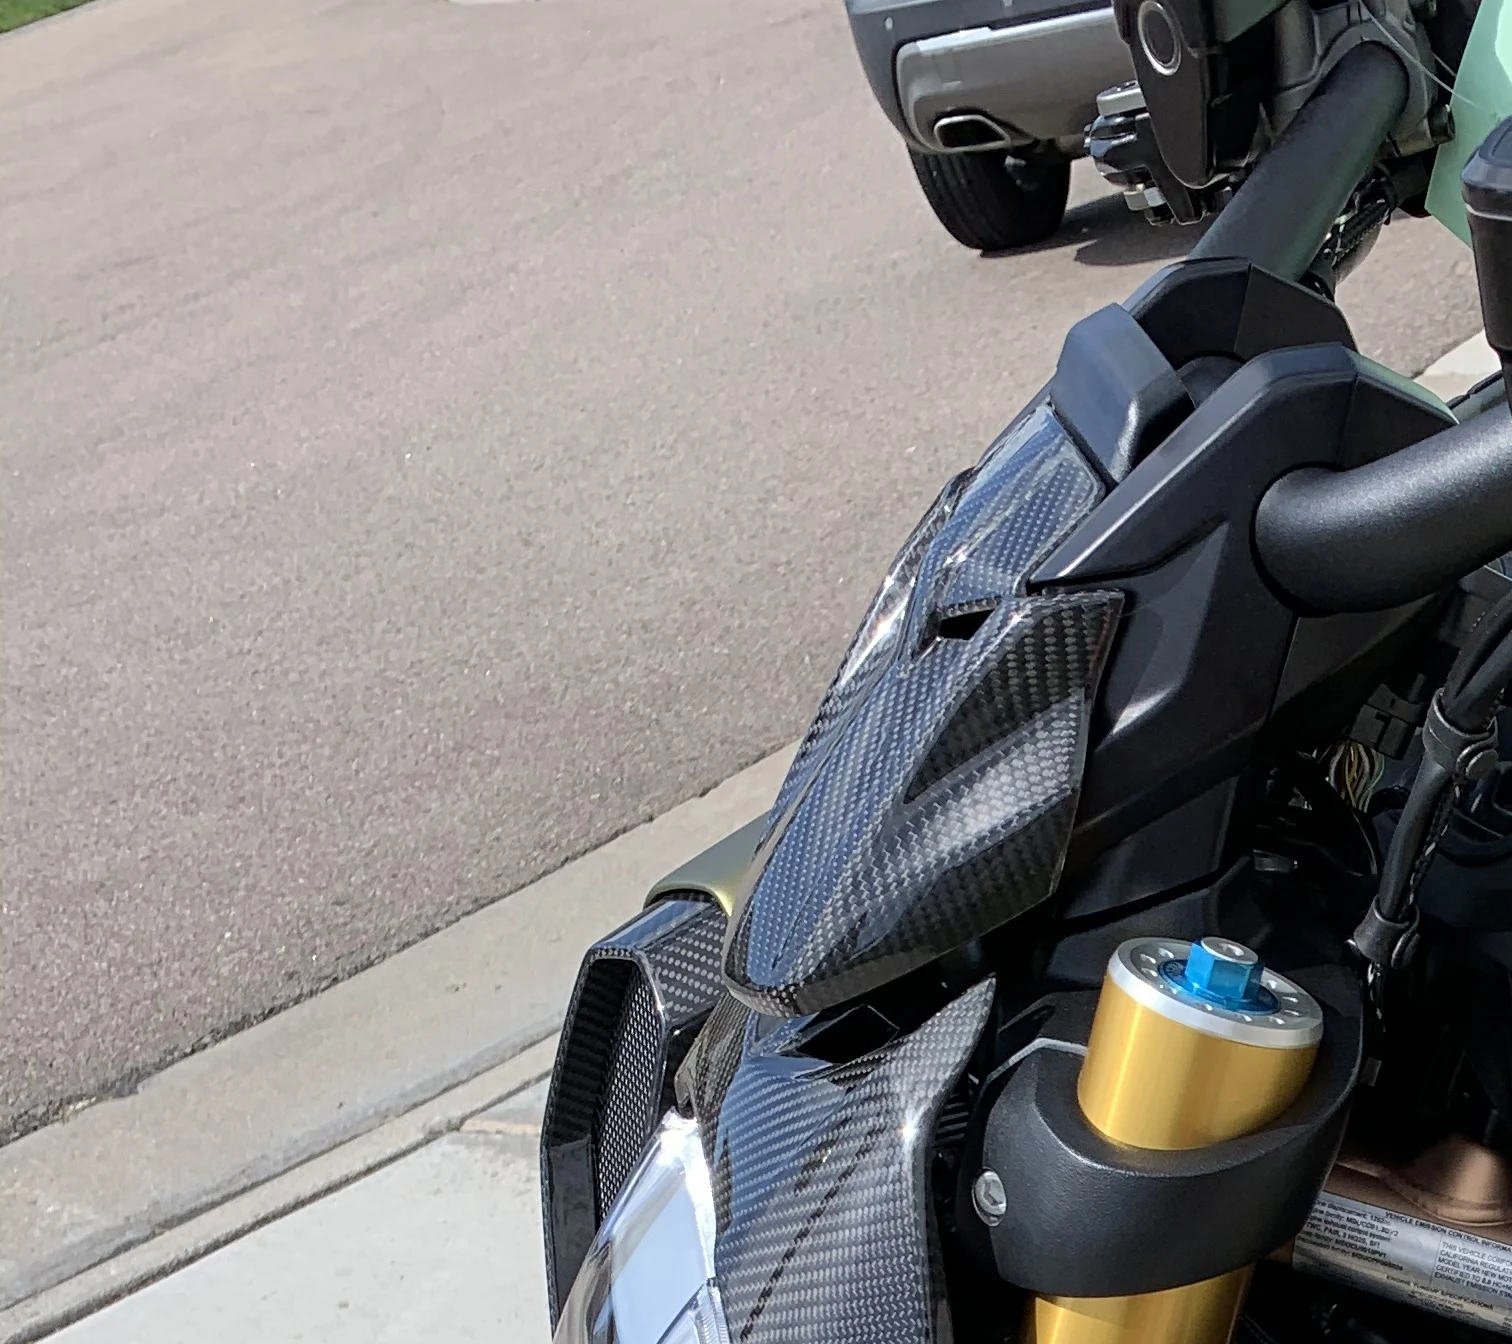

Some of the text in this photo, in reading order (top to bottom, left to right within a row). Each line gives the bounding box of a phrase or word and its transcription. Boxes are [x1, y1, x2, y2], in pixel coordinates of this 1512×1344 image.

[1447, 1230, 1480, 1244] CONTROL
[1439, 1249, 1479, 1265] CALIFORNIA
[1441, 1242, 1457, 1252] THIS
[1457, 1246, 1486, 1259] VEHICLE
[1435, 1264, 1471, 1279] CERTIFIED
[1471, 1274, 1480, 1282] TO
[1437, 1257, 1461, 1268] MODEL
[1461, 1263, 1480, 1274] YEAR
[1480, 1269, 1497, 1278] NEW
[1433, 1271, 1465, 1285] EXHAUST
[1465, 1280, 1497, 1294] EMISSION
